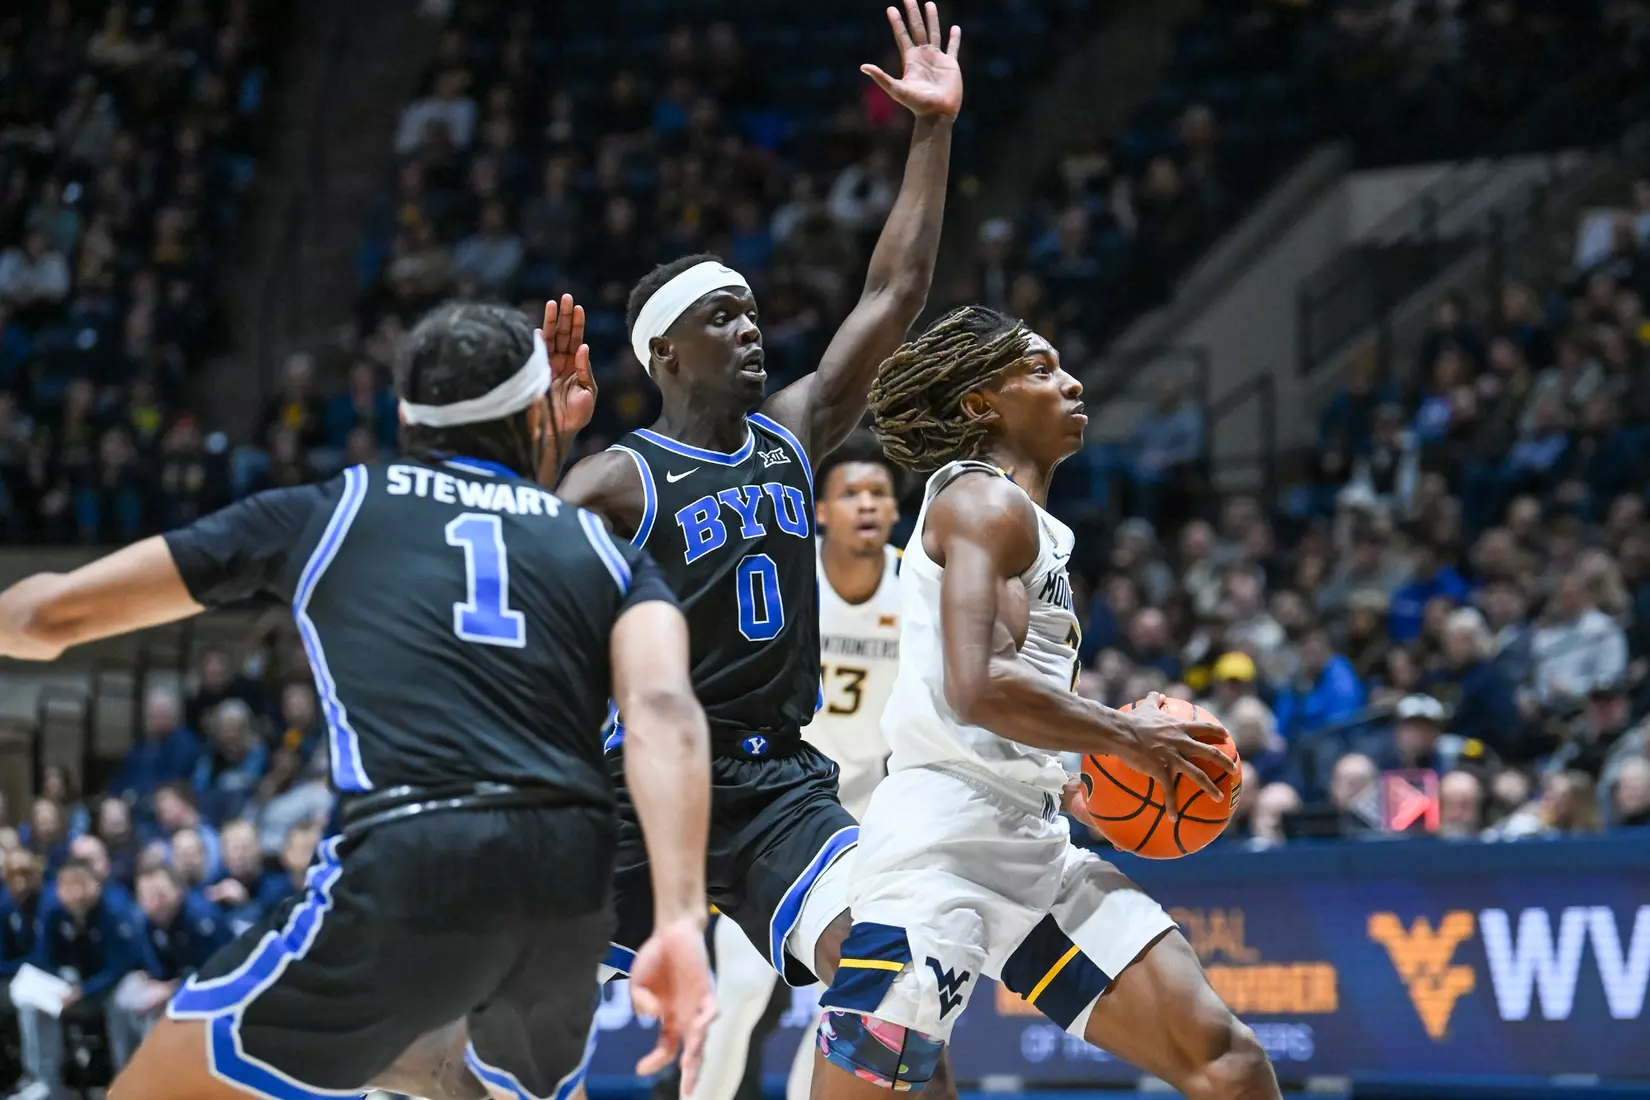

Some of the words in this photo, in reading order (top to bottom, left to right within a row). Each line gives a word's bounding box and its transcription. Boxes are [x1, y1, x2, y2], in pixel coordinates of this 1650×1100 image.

[386, 464, 563, 518] STEWART
[674, 482, 810, 565] BYU
[445, 513, 526, 648] 1
[735, 553, 785, 642] 0
[748, 737, 766, 754] Y
